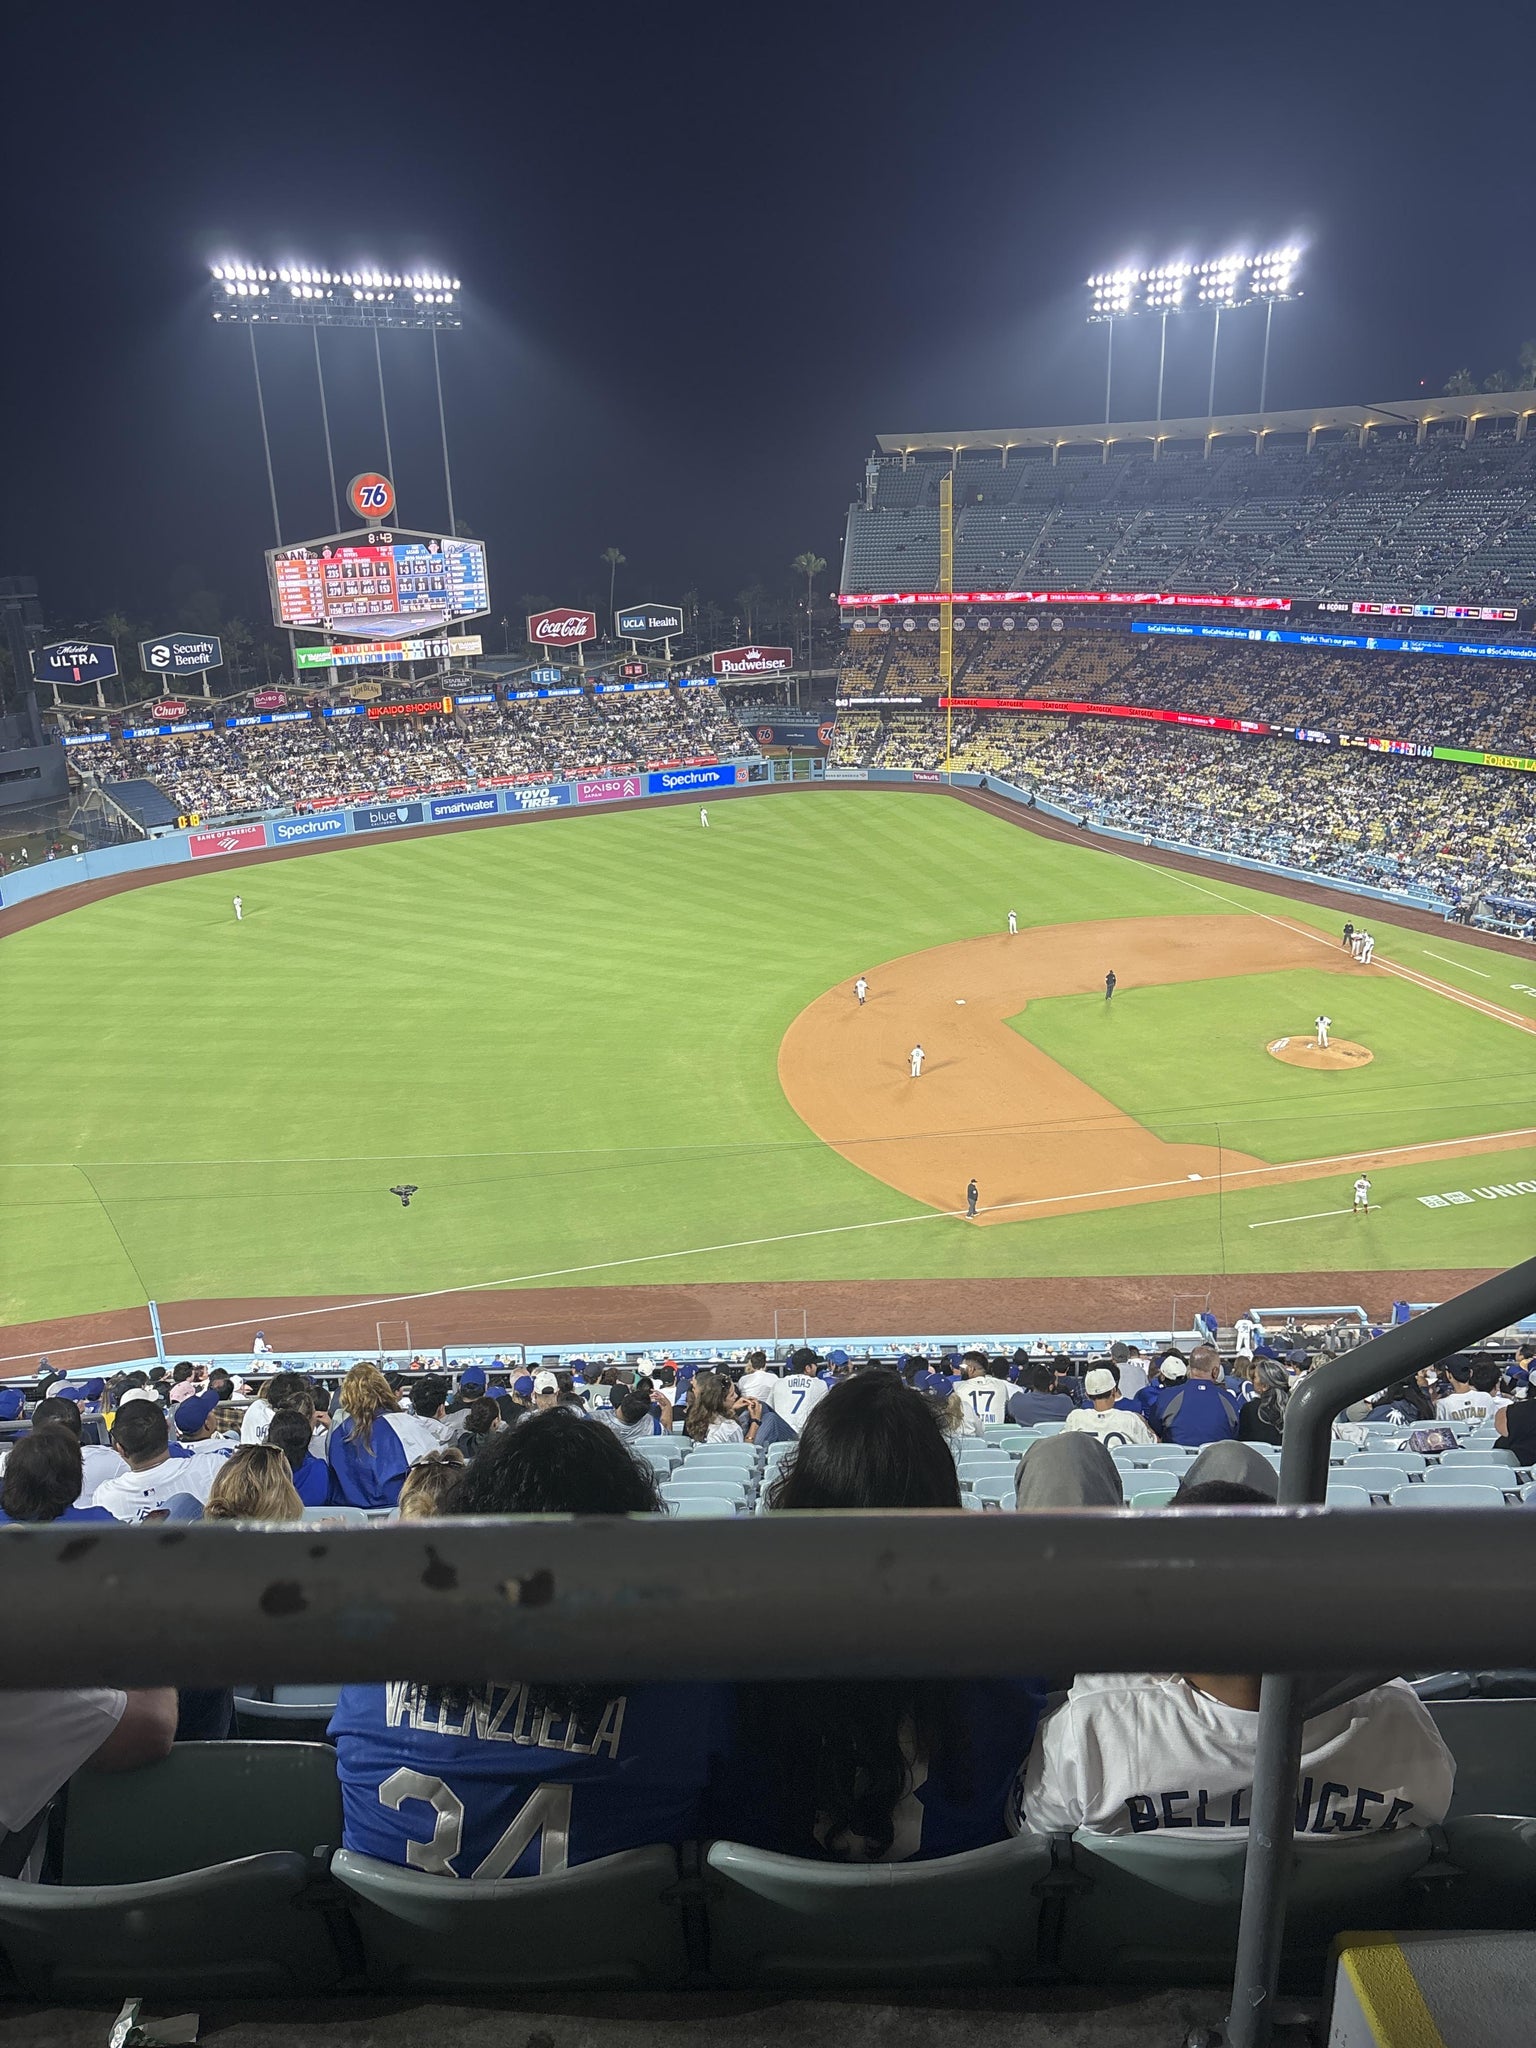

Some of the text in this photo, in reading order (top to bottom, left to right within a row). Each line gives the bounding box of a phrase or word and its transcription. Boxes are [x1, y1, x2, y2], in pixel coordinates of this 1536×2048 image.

[360, 483, 387, 507] 76
[368, 533, 393, 543] 8:43
[536, 617, 589, 638] Coca-Cola
[623, 617, 677, 628] UCLA Health
[173, 642, 214, 653] Security
[1458, 645, 1477, 654] Follow
[50, 653, 98, 667] ULTRA
[175, 653, 211, 665] Benefit
[535, 671, 557, 681] TEL
[154, 705, 185, 716] Churu
[368, 705, 404, 717] NIKAIDO
[405, 702, 441, 713] SHOCHU
[760, 729, 771, 739] 76
[1483, 754, 1522, 768] FOREST
[662, 771, 715, 787] Spectrum
[514, 789, 550, 800] TOYO
[583, 783, 620, 793] DAISO
[434, 800, 495, 816] smartwater
[521, 797, 558, 808] TIRES
[178, 814, 200, 829] 0:18
[370, 810, 397, 822] blue
[197, 833, 215, 841] BANK
[225, 827, 256, 837] AMERICA
[277, 820, 337, 839] Spectrum
[791, 1390, 805, 1414] 7
[968, 1390, 995, 1412] 17
[386, 1680, 627, 1759] VALENZUELA
[1124, 1777, 1414, 1833] BELLGER
[378, 1766, 573, 1878] 34
